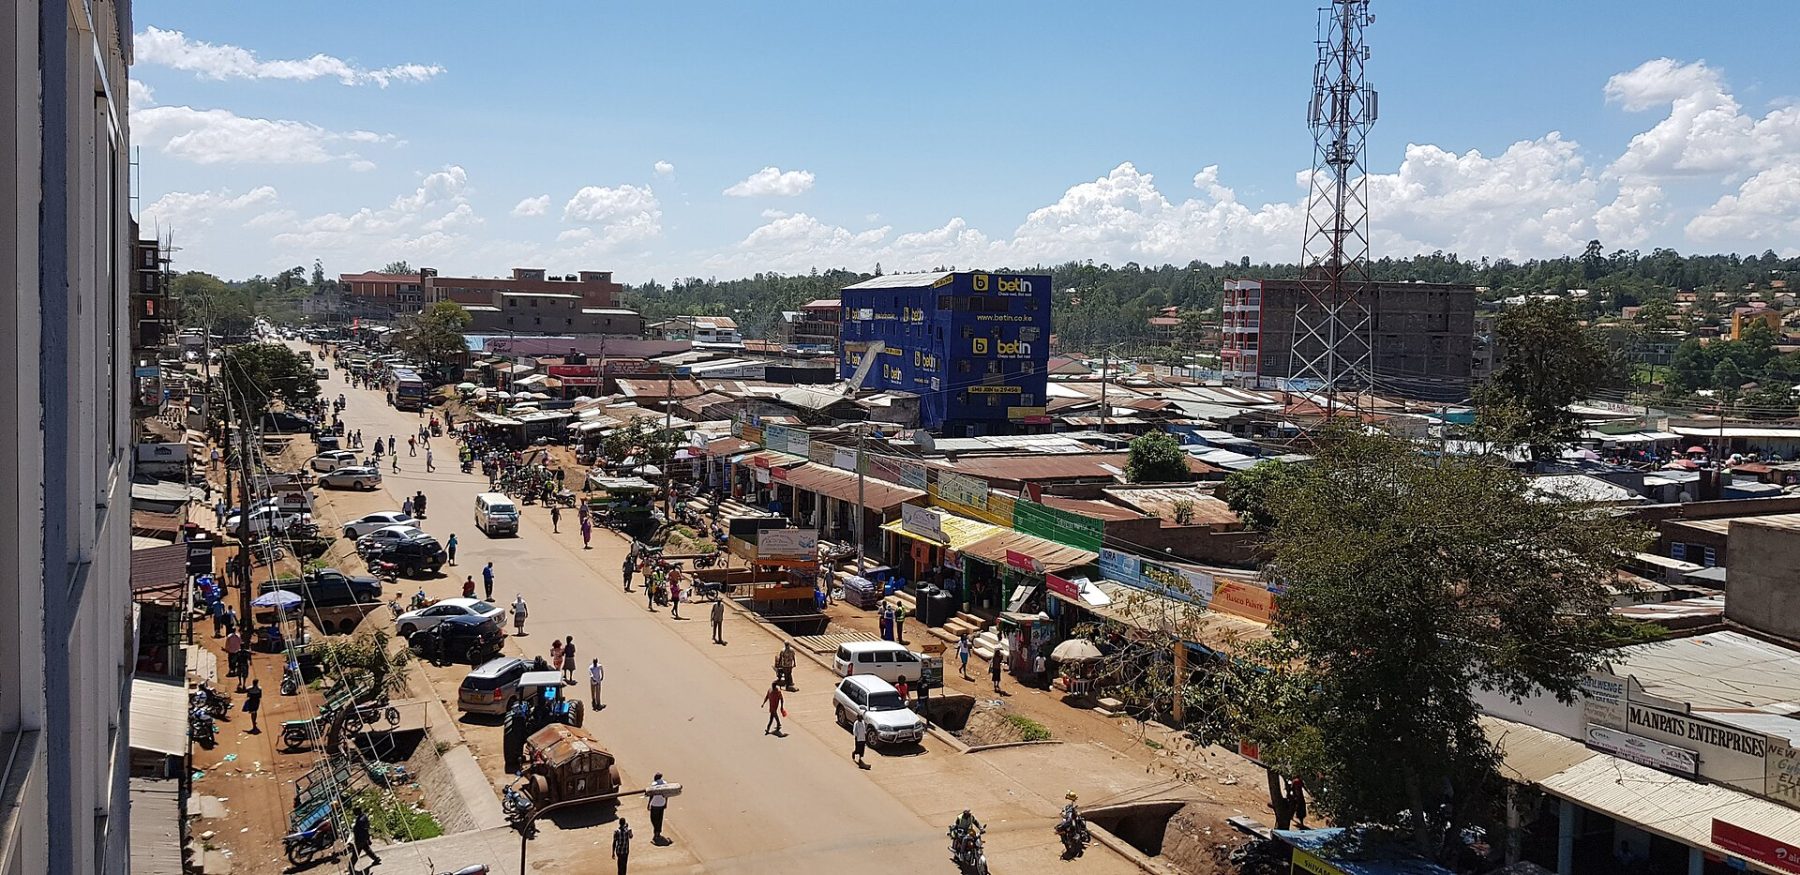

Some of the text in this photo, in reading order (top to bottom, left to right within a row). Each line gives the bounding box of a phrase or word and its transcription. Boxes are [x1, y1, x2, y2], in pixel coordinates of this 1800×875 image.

[998, 276, 1032, 292] betin
[976, 314, 1033, 322] www.betin.co.ke
[997, 339, 1031, 354] betin
[1629, 706, 1685, 736] MANPATS
[1688, 722, 1765, 758] ENTERPRISES
[1768, 744, 1797, 759] NEW
